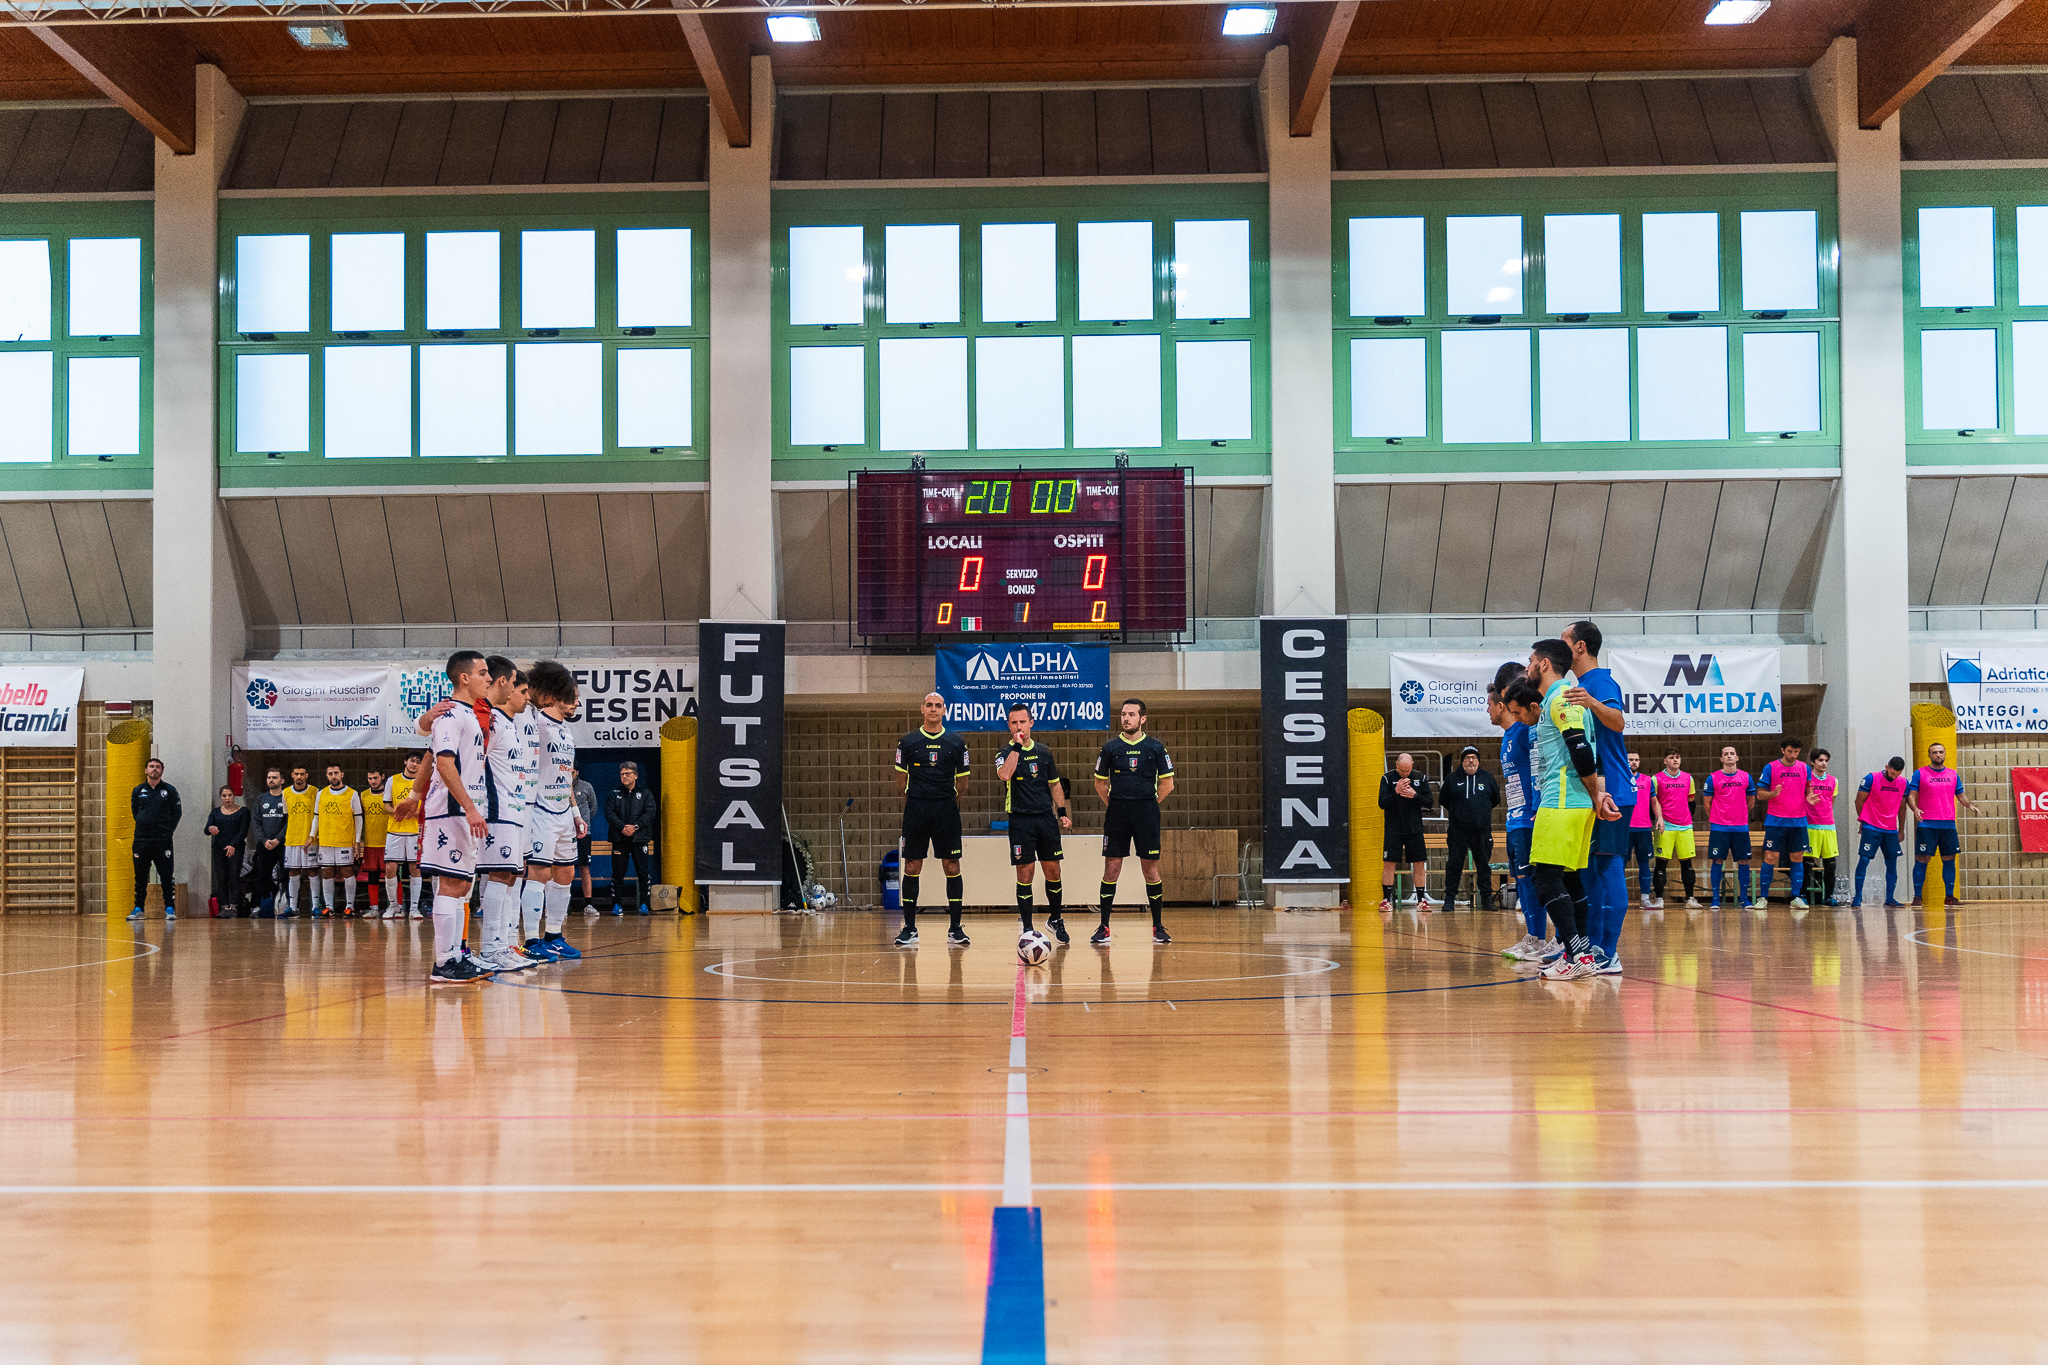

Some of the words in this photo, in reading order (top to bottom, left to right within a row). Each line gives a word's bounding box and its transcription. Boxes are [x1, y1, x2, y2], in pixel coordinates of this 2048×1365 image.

[923, 487, 956, 498] TIME-OUT
[965, 480, 1012, 514] 20
[1030, 479, 1077, 514] 00
[1086, 485, 1119, 496] TIME-OUT
[928, 535, 982, 550] LOCALI
[1053, 534, 1104, 548] OSPITI
[959, 556, 984, 591] 0
[1006, 568, 1038, 580] SERVIZIO
[1082, 555, 1107, 590] 0
[1008, 584, 1036, 595] BONUS
[937, 603, 952, 624] 0
[1091, 601, 1107, 622] 0
[1000, 651, 1079, 672] ALPHA
[571, 669, 694, 694] FUTSAL
[1428, 680, 1478, 694] Giorgini
[282, 685, 325, 697] Giorgini
[329, 684, 380, 695] Rusciano
[1000, 692, 1037, 700] PROPONE
[1037, 692, 1046, 700] IN
[1429, 694, 1486, 705] Rusciano
[1622, 691, 1777, 714] NEXTMEDIA
[943, 702, 1008, 722] VENDITA
[1012, 701, 1104, 721] 47.071408
[329, 714, 379, 731] UnipolSai
[1663, 718, 1675, 728] di
[1679, 717, 1777, 729] Comunicazione
[1985, 719, 2014, 730] VITA
[594, 726, 639, 741] calcio
[644, 730, 653, 741] a
[713, 633, 765, 871] FUTSAL
[1279, 629, 1332, 869] CESENA
